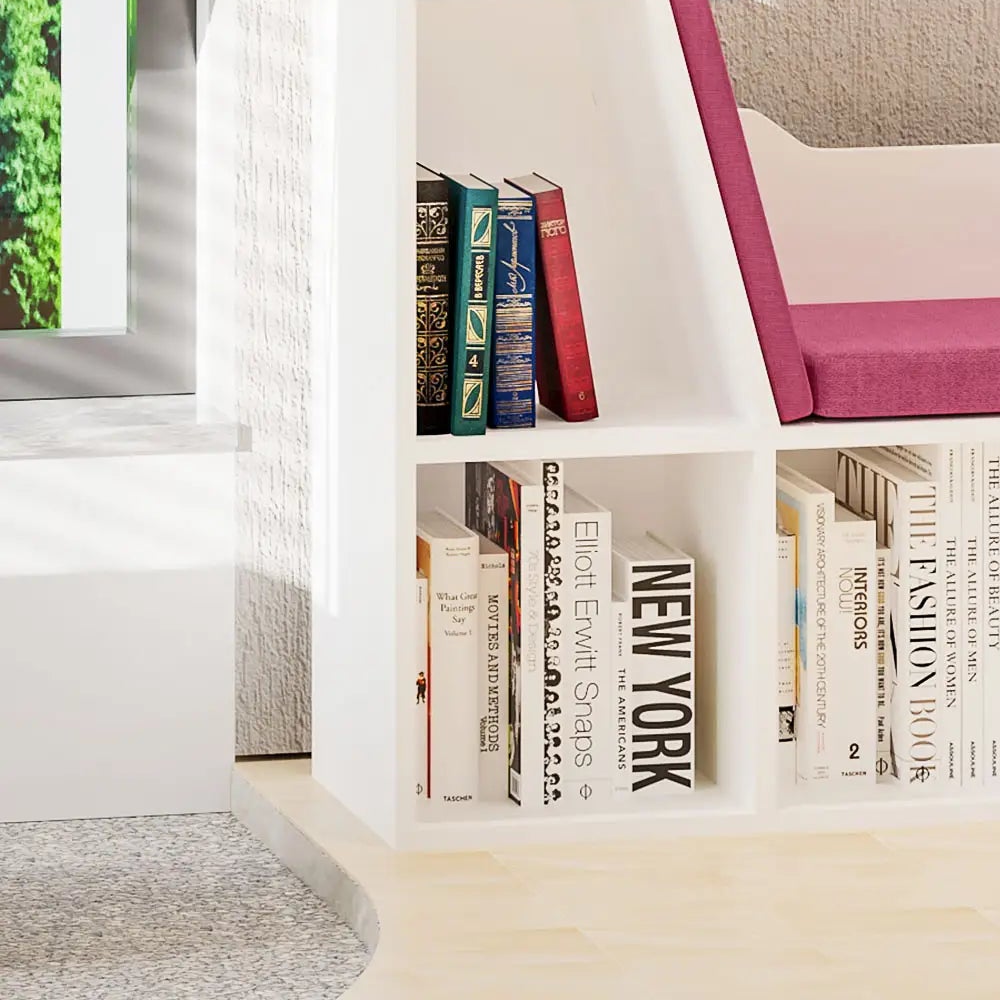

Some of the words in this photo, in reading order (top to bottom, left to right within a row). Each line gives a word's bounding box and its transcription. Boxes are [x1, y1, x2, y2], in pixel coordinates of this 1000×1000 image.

[469, 354, 479, 368] 4
[988, 456, 999, 490] THE
[909, 485, 936, 550] THE
[988, 494, 999, 557] ALLURE
[574, 521, 599, 590] Elliott
[946, 537, 956, 567] THE
[967, 536, 977, 567] THE
[988, 560, 999, 581] OF
[440, 603, 476, 614] Paintings
[452, 614, 467, 625] Say
[487, 594, 499, 651] MOVIES
[631, 563, 691, 659] NEW
[853, 567, 868, 650] INTERIORS
[909, 558, 937, 688] FASHION
[946, 570, 956, 626] ALLURE
[967, 570, 977, 625] ALLURE
[988, 586, 999, 650] BEAUTY
[574, 599, 599, 672] Erwitt
[946, 629, 956, 649] OF
[967, 628, 977, 648] OF
[487, 654, 499, 684] AND
[618, 668, 626, 692] THE
[946, 651, 956, 708] WOMEN
[967, 651, 977, 682] MEN
[488, 686, 500, 753] METHODS
[569, 681, 599, 768] Snaps
[618, 696, 626, 770] AMERICANS
[631, 671, 693, 793] YORK
[849, 743, 860, 760] 2
